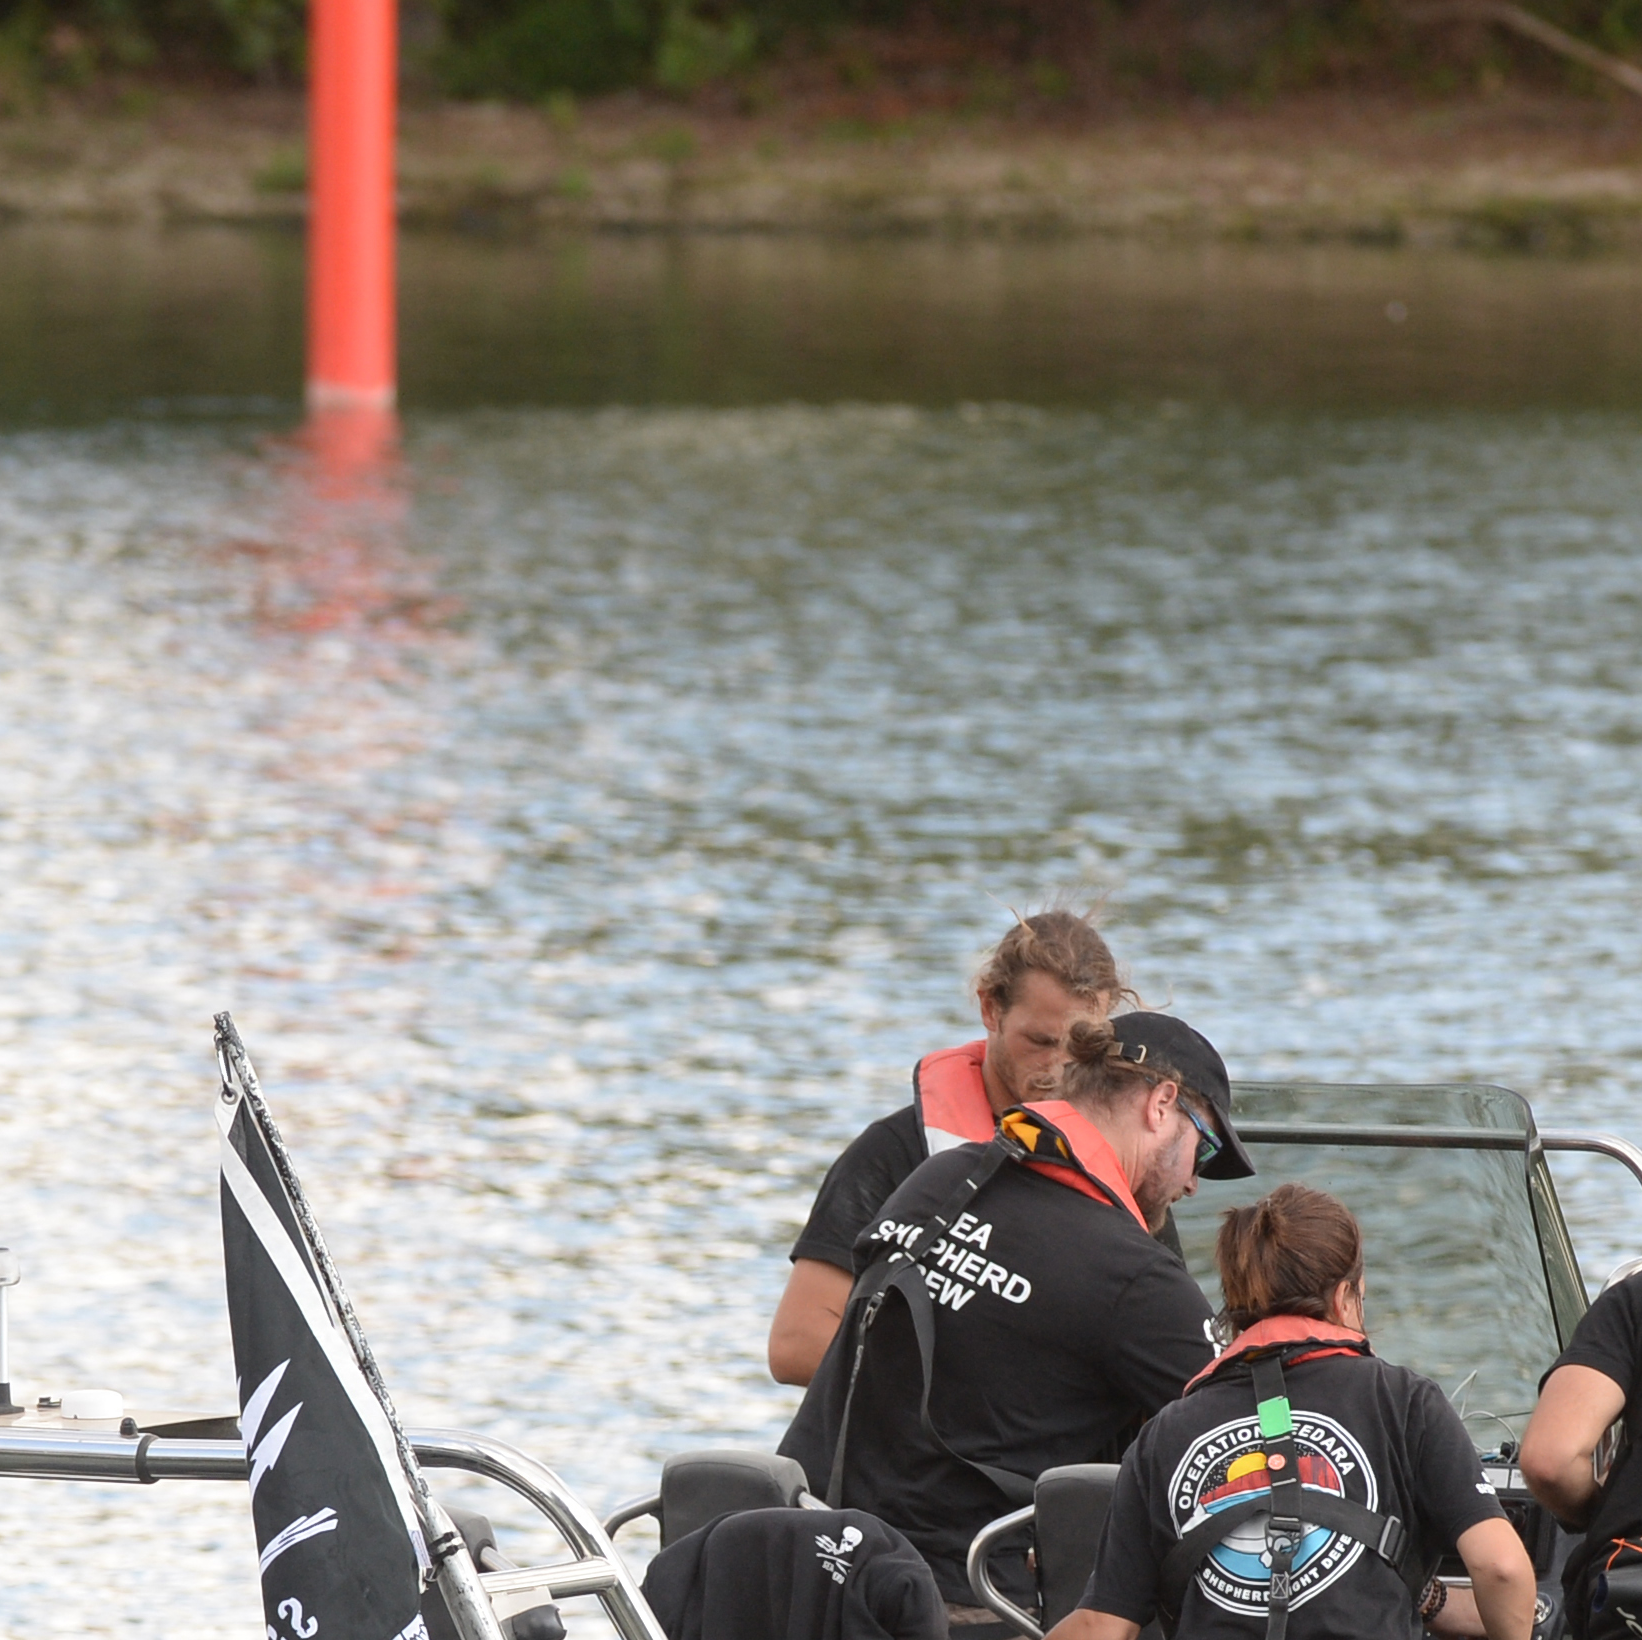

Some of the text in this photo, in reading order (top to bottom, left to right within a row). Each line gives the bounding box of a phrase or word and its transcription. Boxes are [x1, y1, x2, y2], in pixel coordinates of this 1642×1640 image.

[945, 1211, 993, 1251] EA
[887, 1251, 977, 1312] EW
[1290, 1422, 1356, 1476] EEDARA
[1288, 1567, 1320, 1597] IGHT
[1320, 1533, 1353, 1570] DEFE
